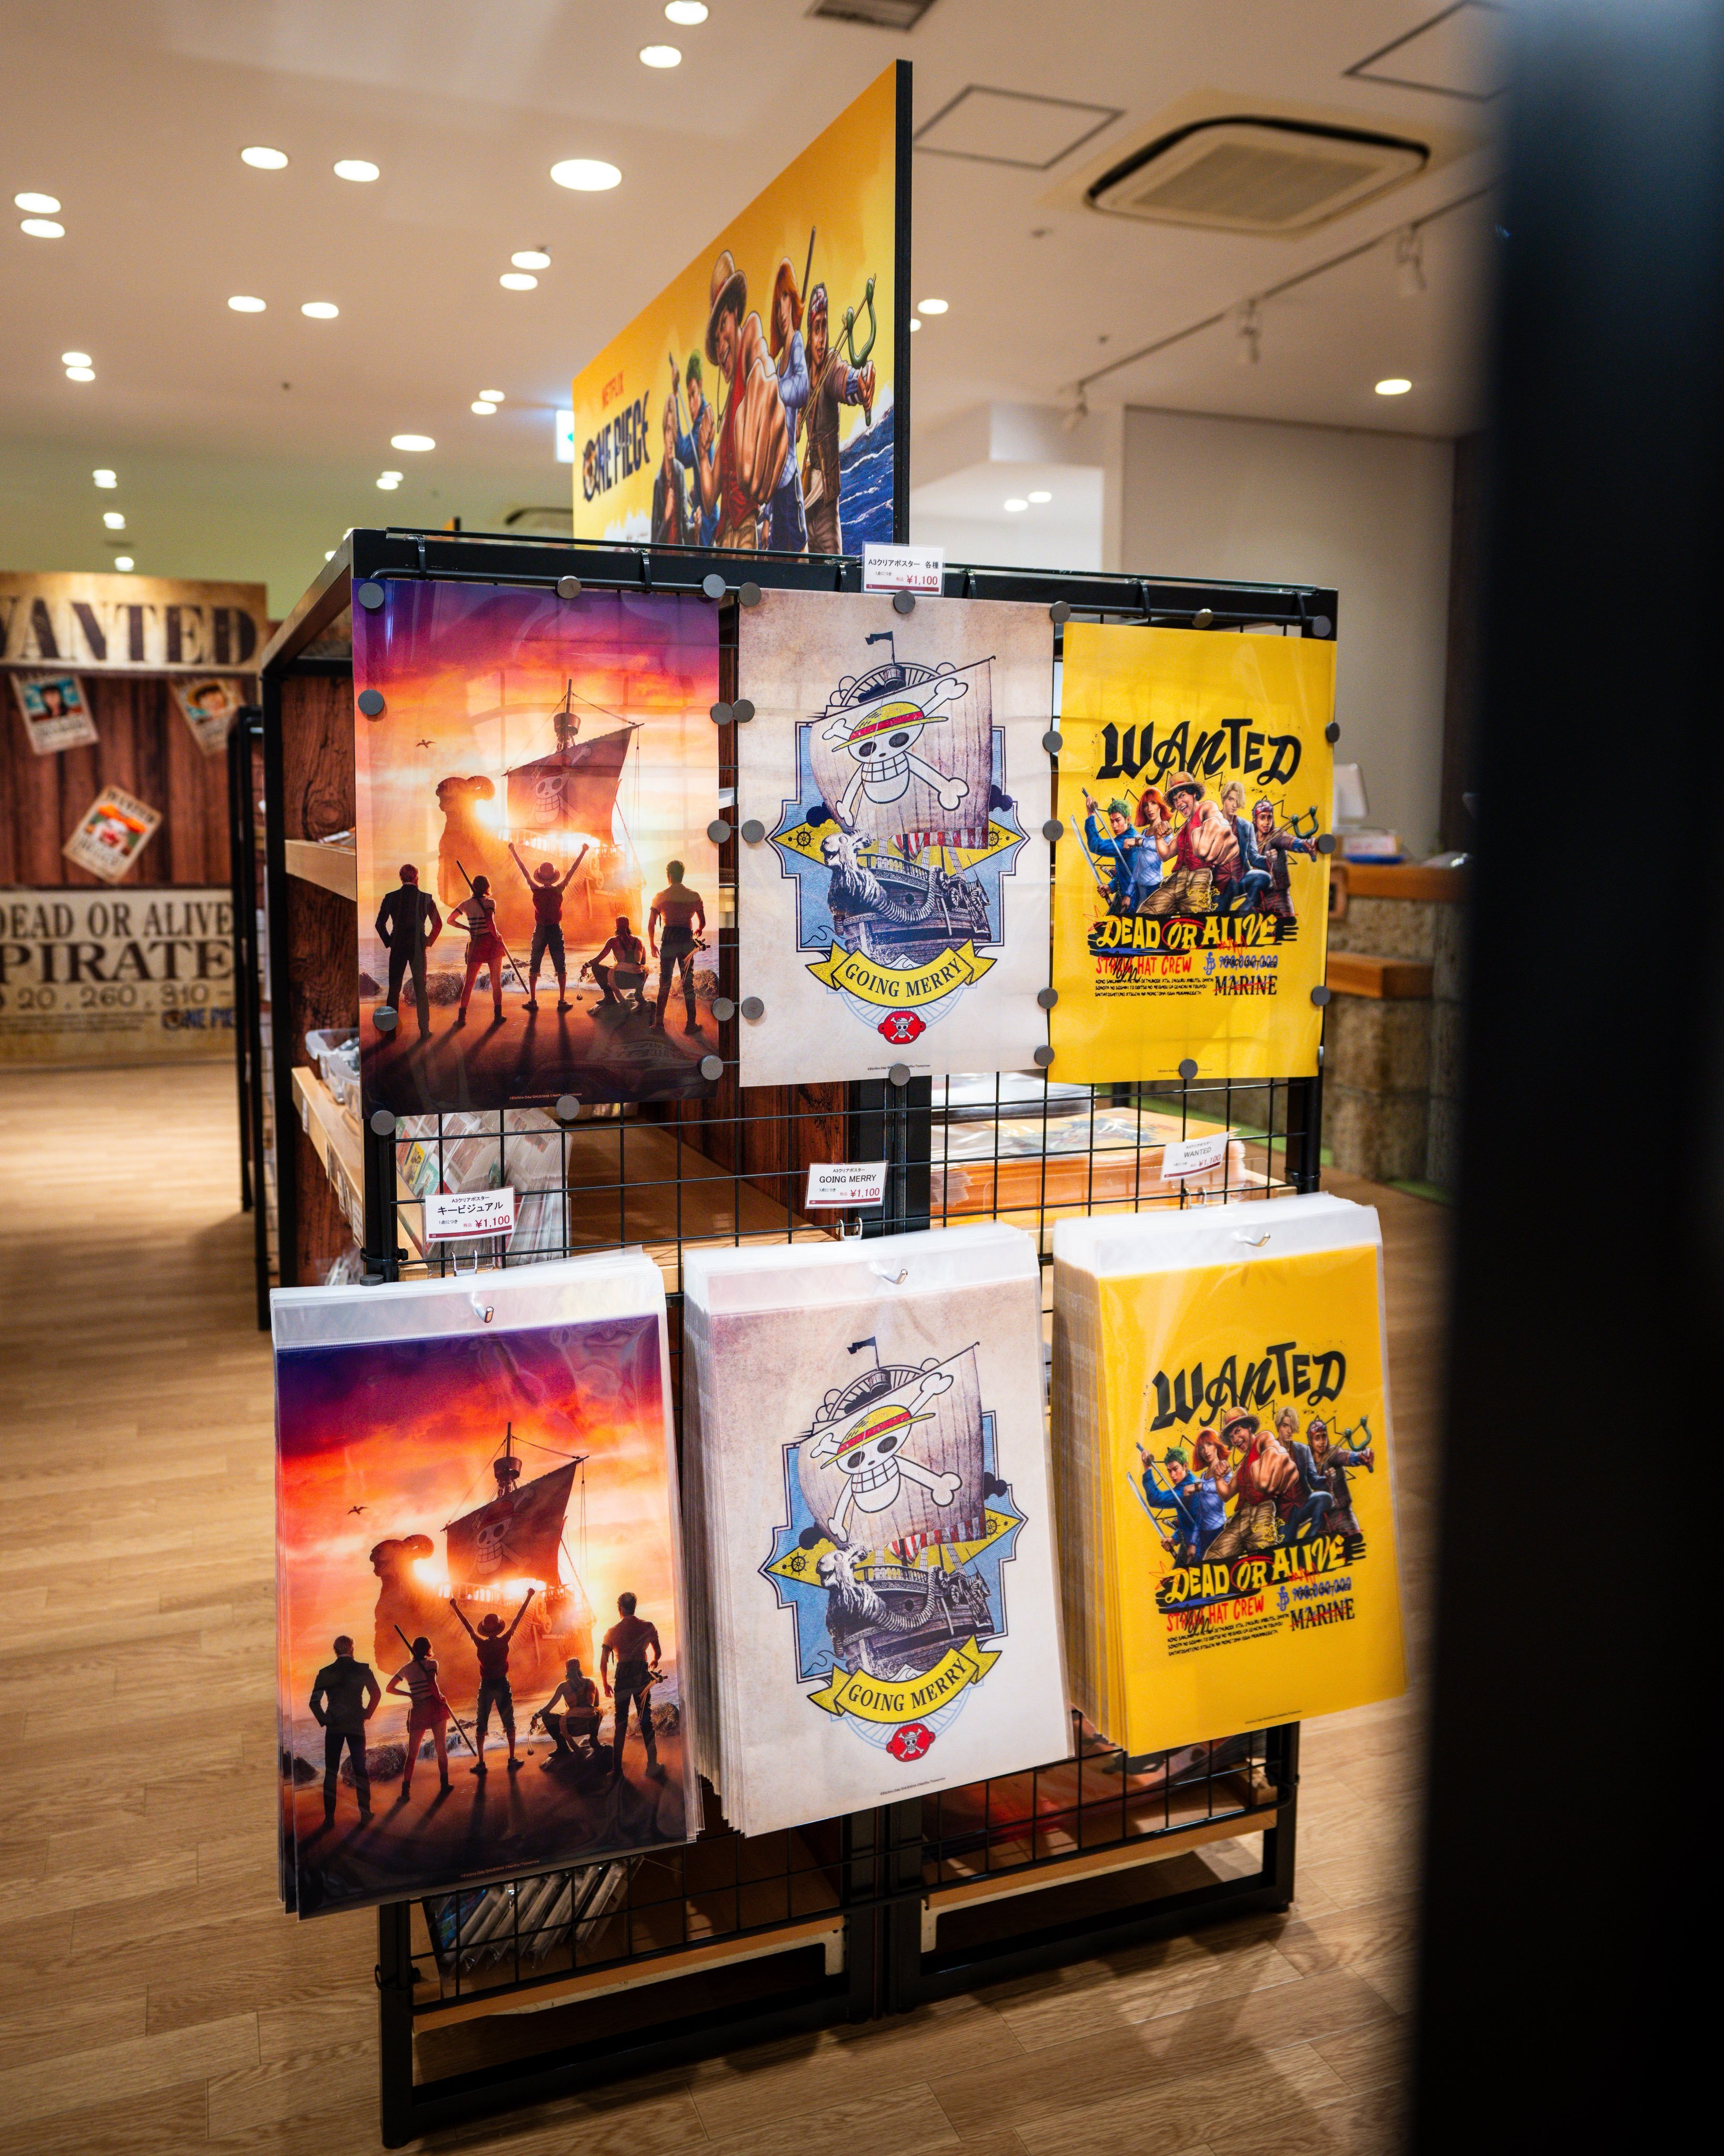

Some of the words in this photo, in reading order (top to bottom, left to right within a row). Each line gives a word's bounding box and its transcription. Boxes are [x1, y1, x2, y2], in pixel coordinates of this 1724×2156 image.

[583, 423, 612, 502] ONE
[614, 388, 650, 485] PIECE
[868, 558, 920, 567] A3クリアポスター
[907, 574, 938, 586] ¥1,100
[1096, 718, 1302, 786] WANTED
[0, 902, 74, 939] EAD
[87, 902, 131, 939] OR
[143, 901, 233, 937] ALIVE
[1096, 914, 1161, 949] DEAD
[1167, 921, 1198, 950] OR
[1201, 912, 1278, 946] ALIVE
[845, 963, 900, 997] GOING
[906, 957, 962, 998] MERRY
[1137, 956, 1157, 975] HAT
[1161, 956, 1192, 975] CREW
[1214, 975, 1278, 996] MARINE
[1184, 1147, 1211, 1158] WANTED
[1198, 1154, 1221, 1167] ¥1,100
[849, 1174, 877, 1183] MERRY
[850, 1187, 880, 1197] ¥1,100
[437, 1202, 503, 1215] キービジュアル
[475, 1215, 510, 1228] ¥1,100
[1150, 1341, 1346, 1432] WANTED
[1165, 1564, 1229, 1603] DEAD
[1237, 1561, 1269, 1591] OR
[1272, 1534, 1346, 1580] ALIVE
[1208, 1602, 1229, 1625] HAT
[1233, 1595, 1264, 1620] CREW
[1290, 1598, 1355, 1631] MARINE
[848, 1684, 904, 1712] GOING
[910, 1658, 968, 1709] MERRY
